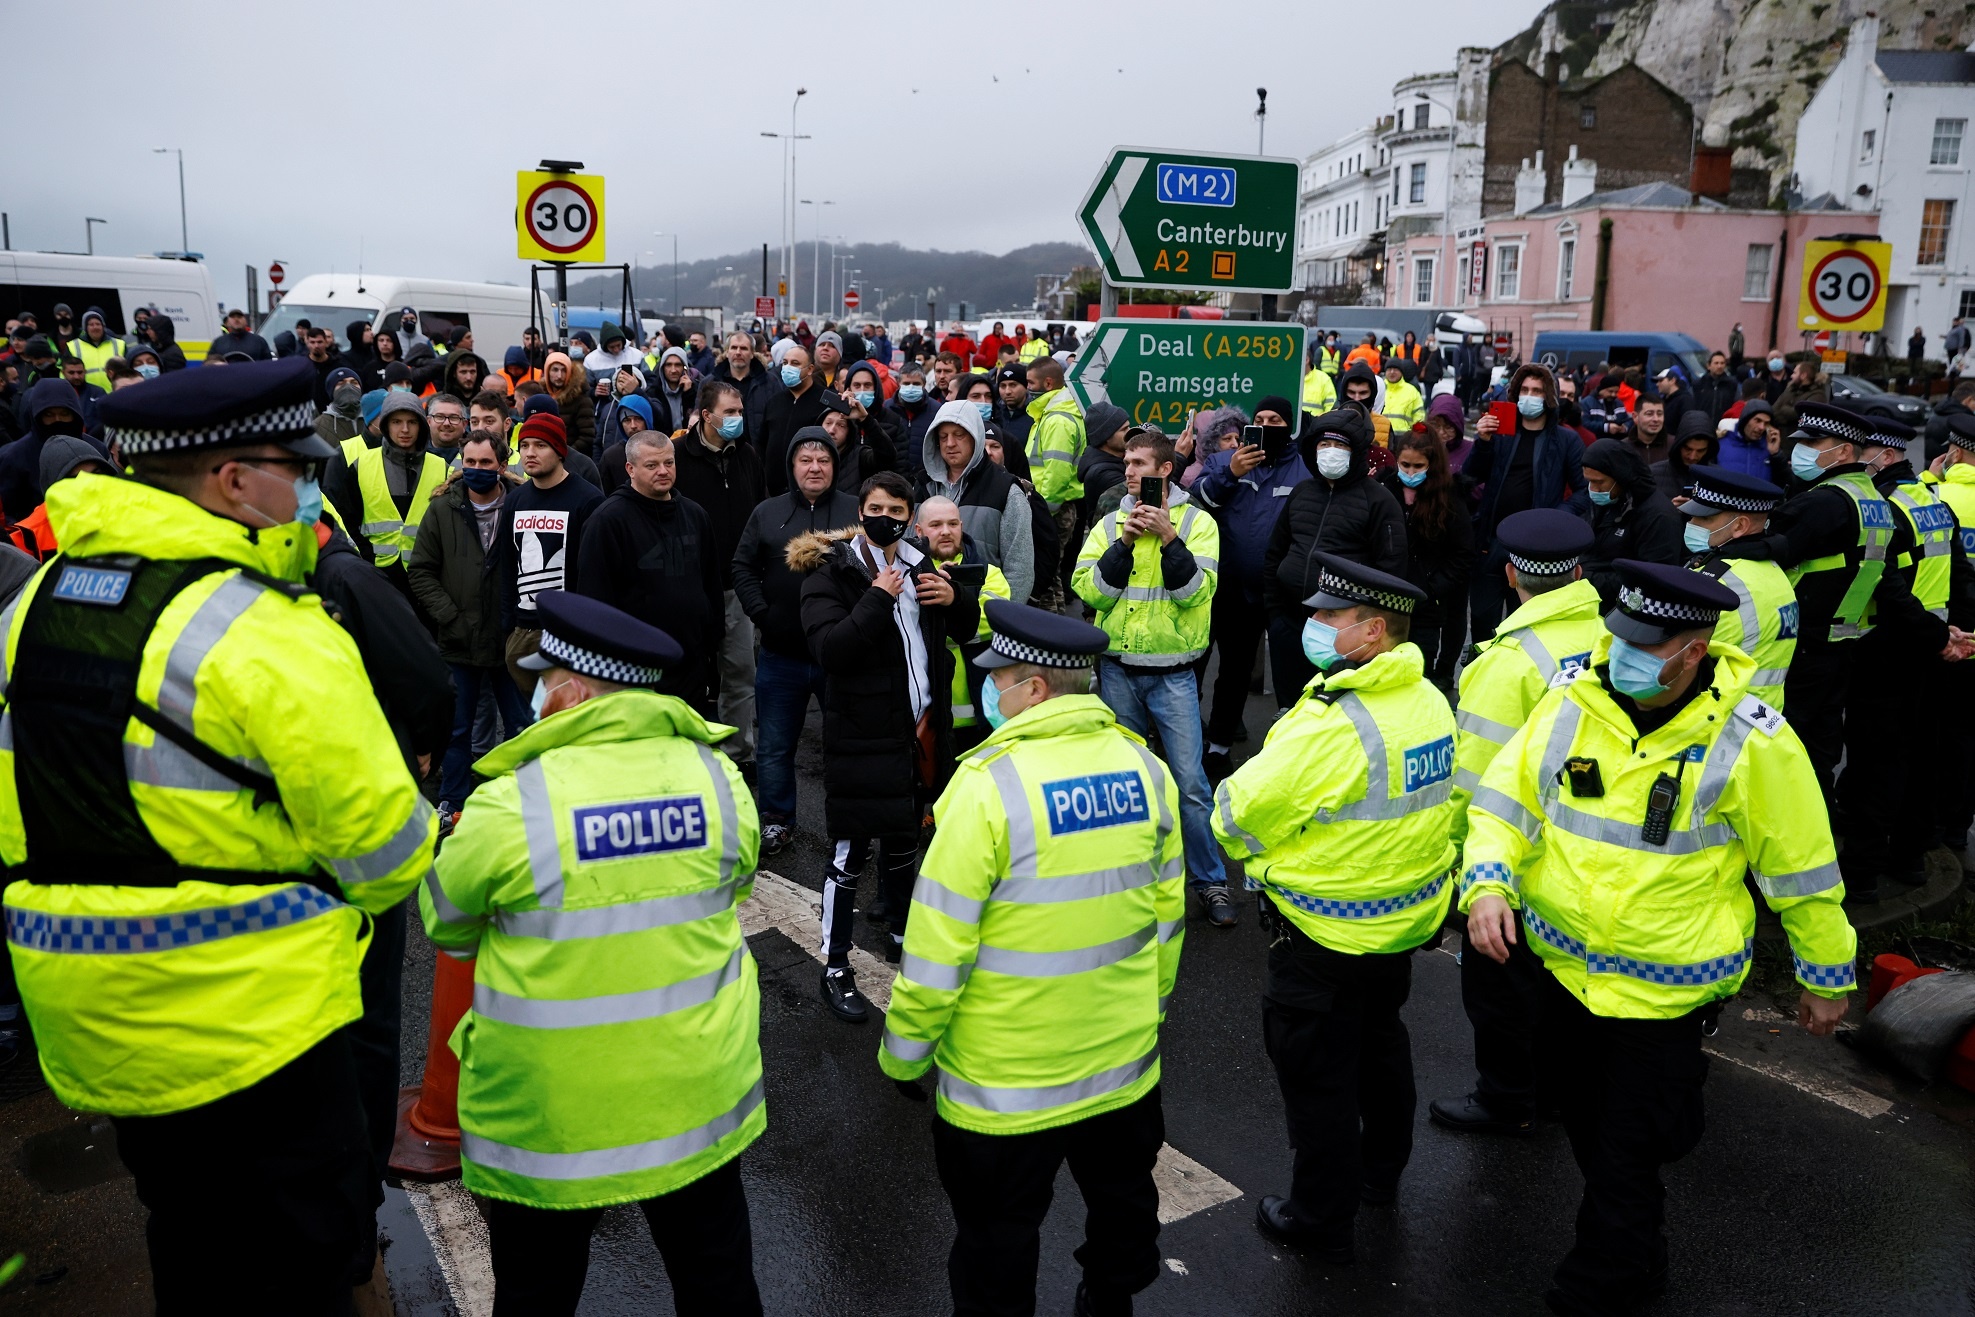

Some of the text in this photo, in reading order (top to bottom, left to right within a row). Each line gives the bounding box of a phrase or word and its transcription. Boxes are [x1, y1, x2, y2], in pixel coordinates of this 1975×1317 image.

[1163, 168, 1231, 201] (M2)
[536, 202, 587, 233] 30
[1157, 218, 1287, 253] Canterbury
[1153, 249, 1190, 273] A2
[1472, 250, 1483, 293] HOTEL
[1819, 271, 1871, 302] 30
[1139, 331, 1295, 361] Deal (A258)
[1137, 370, 1254, 398] Ramsgate
[515, 515, 565, 530] adidas
[1912, 507, 1952, 529] POLICE
[59, 571, 126, 599] POLICE
[1051, 779, 1144, 825] POLICE
[583, 805, 703, 852] POLICE
